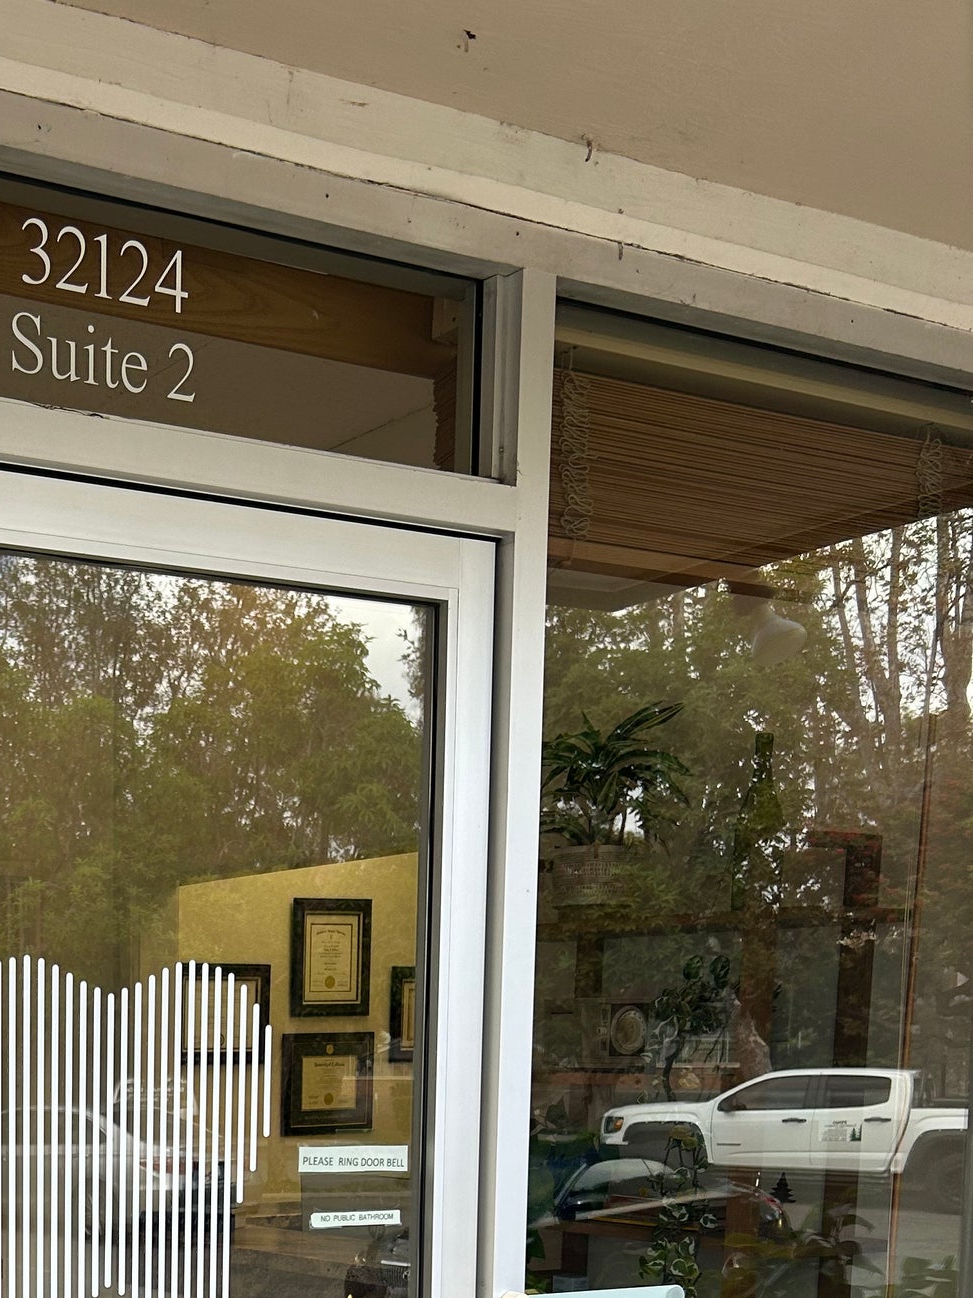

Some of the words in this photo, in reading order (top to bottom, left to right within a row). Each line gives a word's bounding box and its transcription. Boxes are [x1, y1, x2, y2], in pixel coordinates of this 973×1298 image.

[21, 217, 189, 314] 32124
[11, 311, 148, 394] Suite
[167, 342, 196, 403] 2
[302, 1156, 334, 1167] PLEASE
[338, 1157, 359, 1167] RING
[360, 1158, 385, 1168] DOOR
[387, 1158, 405, 1168] BELL
[333, 1214, 356, 1222] PUBLIC
[358, 1213, 394, 1221] BATHROOM
